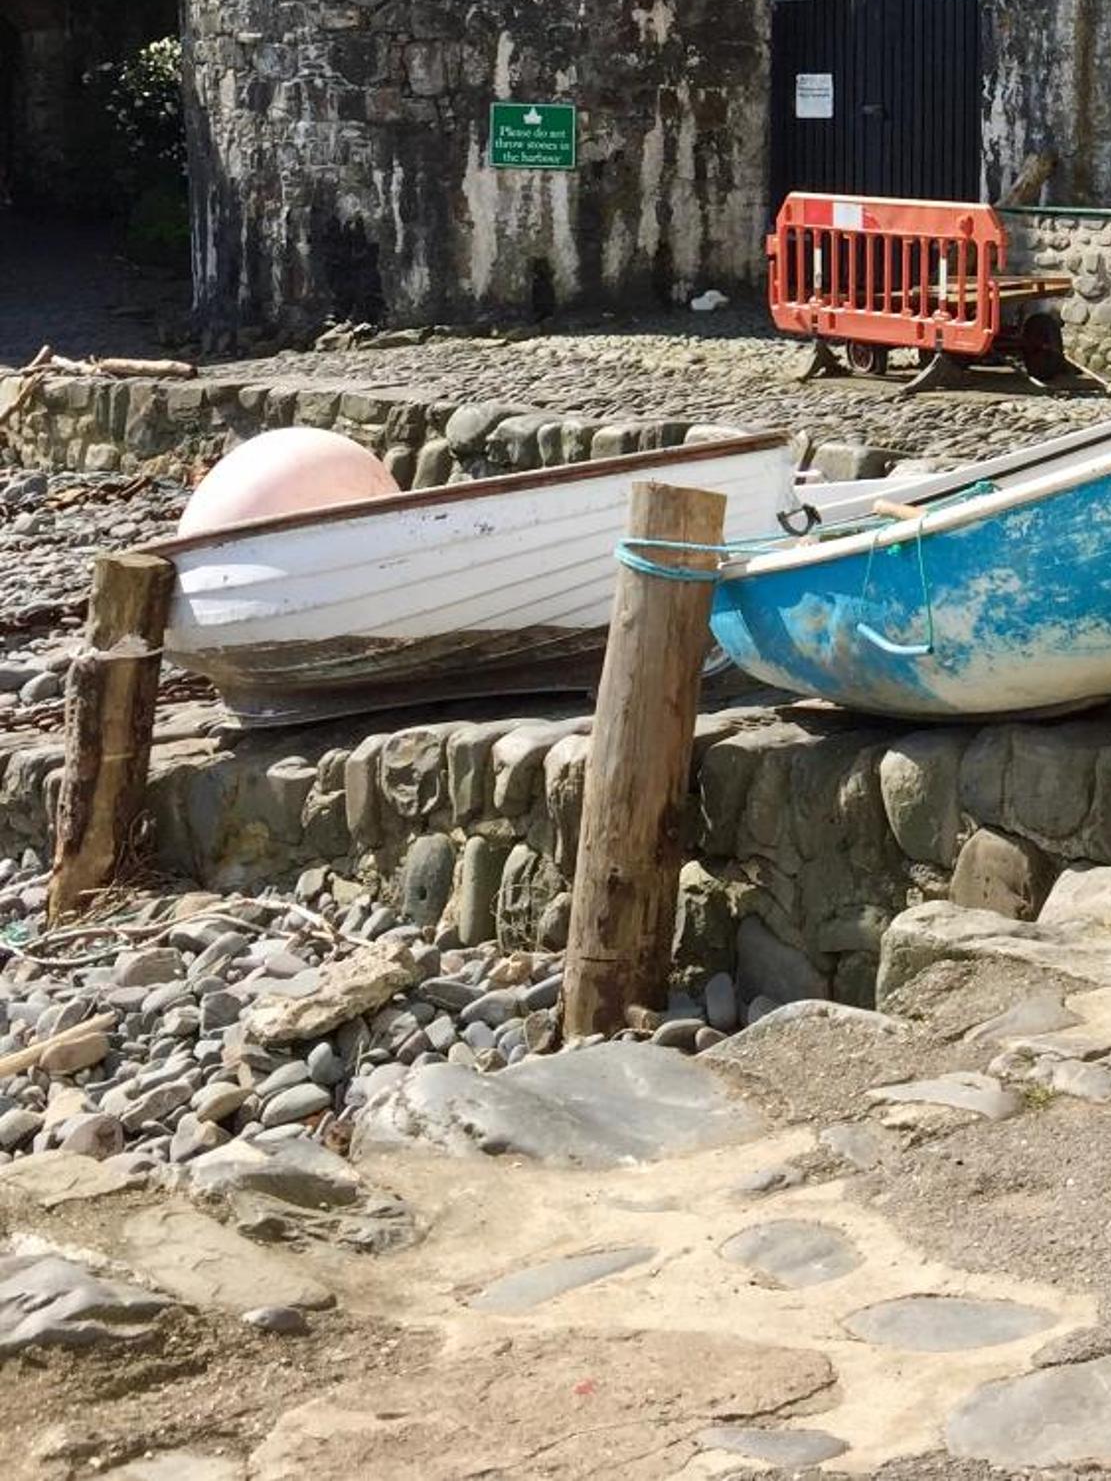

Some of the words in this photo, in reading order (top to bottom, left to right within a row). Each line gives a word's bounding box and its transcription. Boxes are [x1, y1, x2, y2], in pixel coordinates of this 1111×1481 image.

[499, 125, 531, 138] Please
[533, 126, 548, 138] do
[550, 129, 566, 139] not
[503, 151, 520, 162] the
